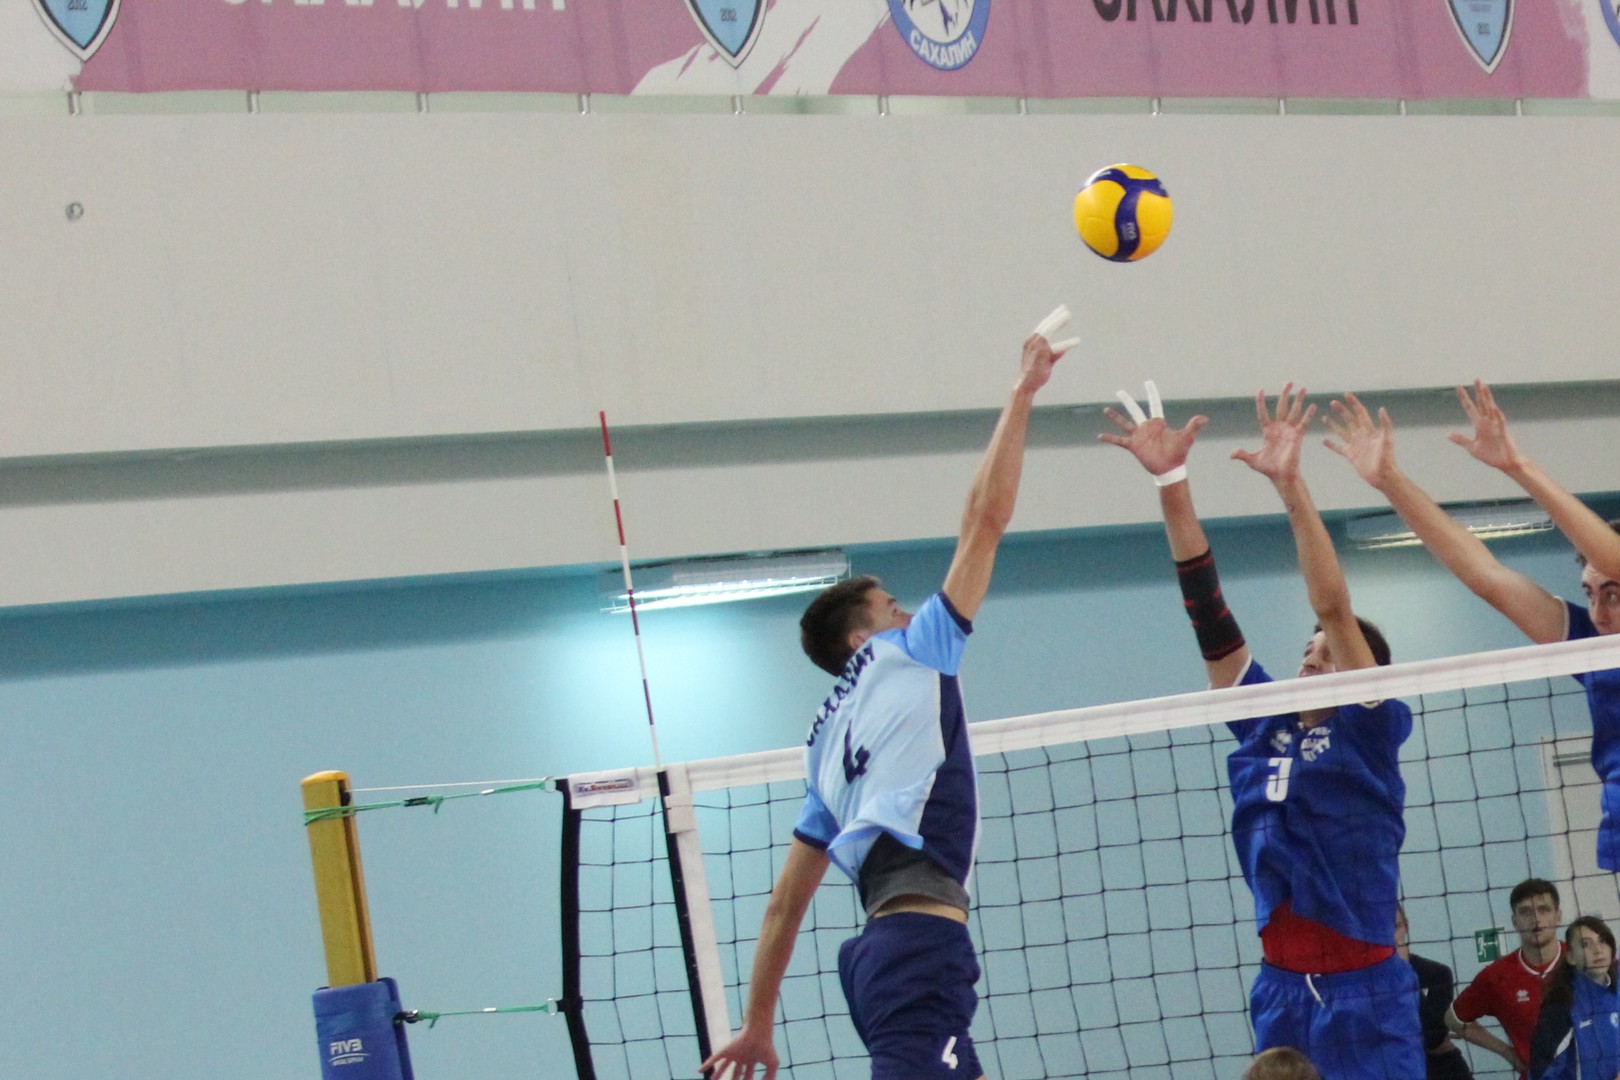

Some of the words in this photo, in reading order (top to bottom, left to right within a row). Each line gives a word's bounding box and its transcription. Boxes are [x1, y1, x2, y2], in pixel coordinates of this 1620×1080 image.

[909, 30, 978, 67] САХАЛИН
[843, 719, 871, 784] 4
[330, 1038, 363, 1055] FIVB
[942, 1035, 959, 1070] 4
